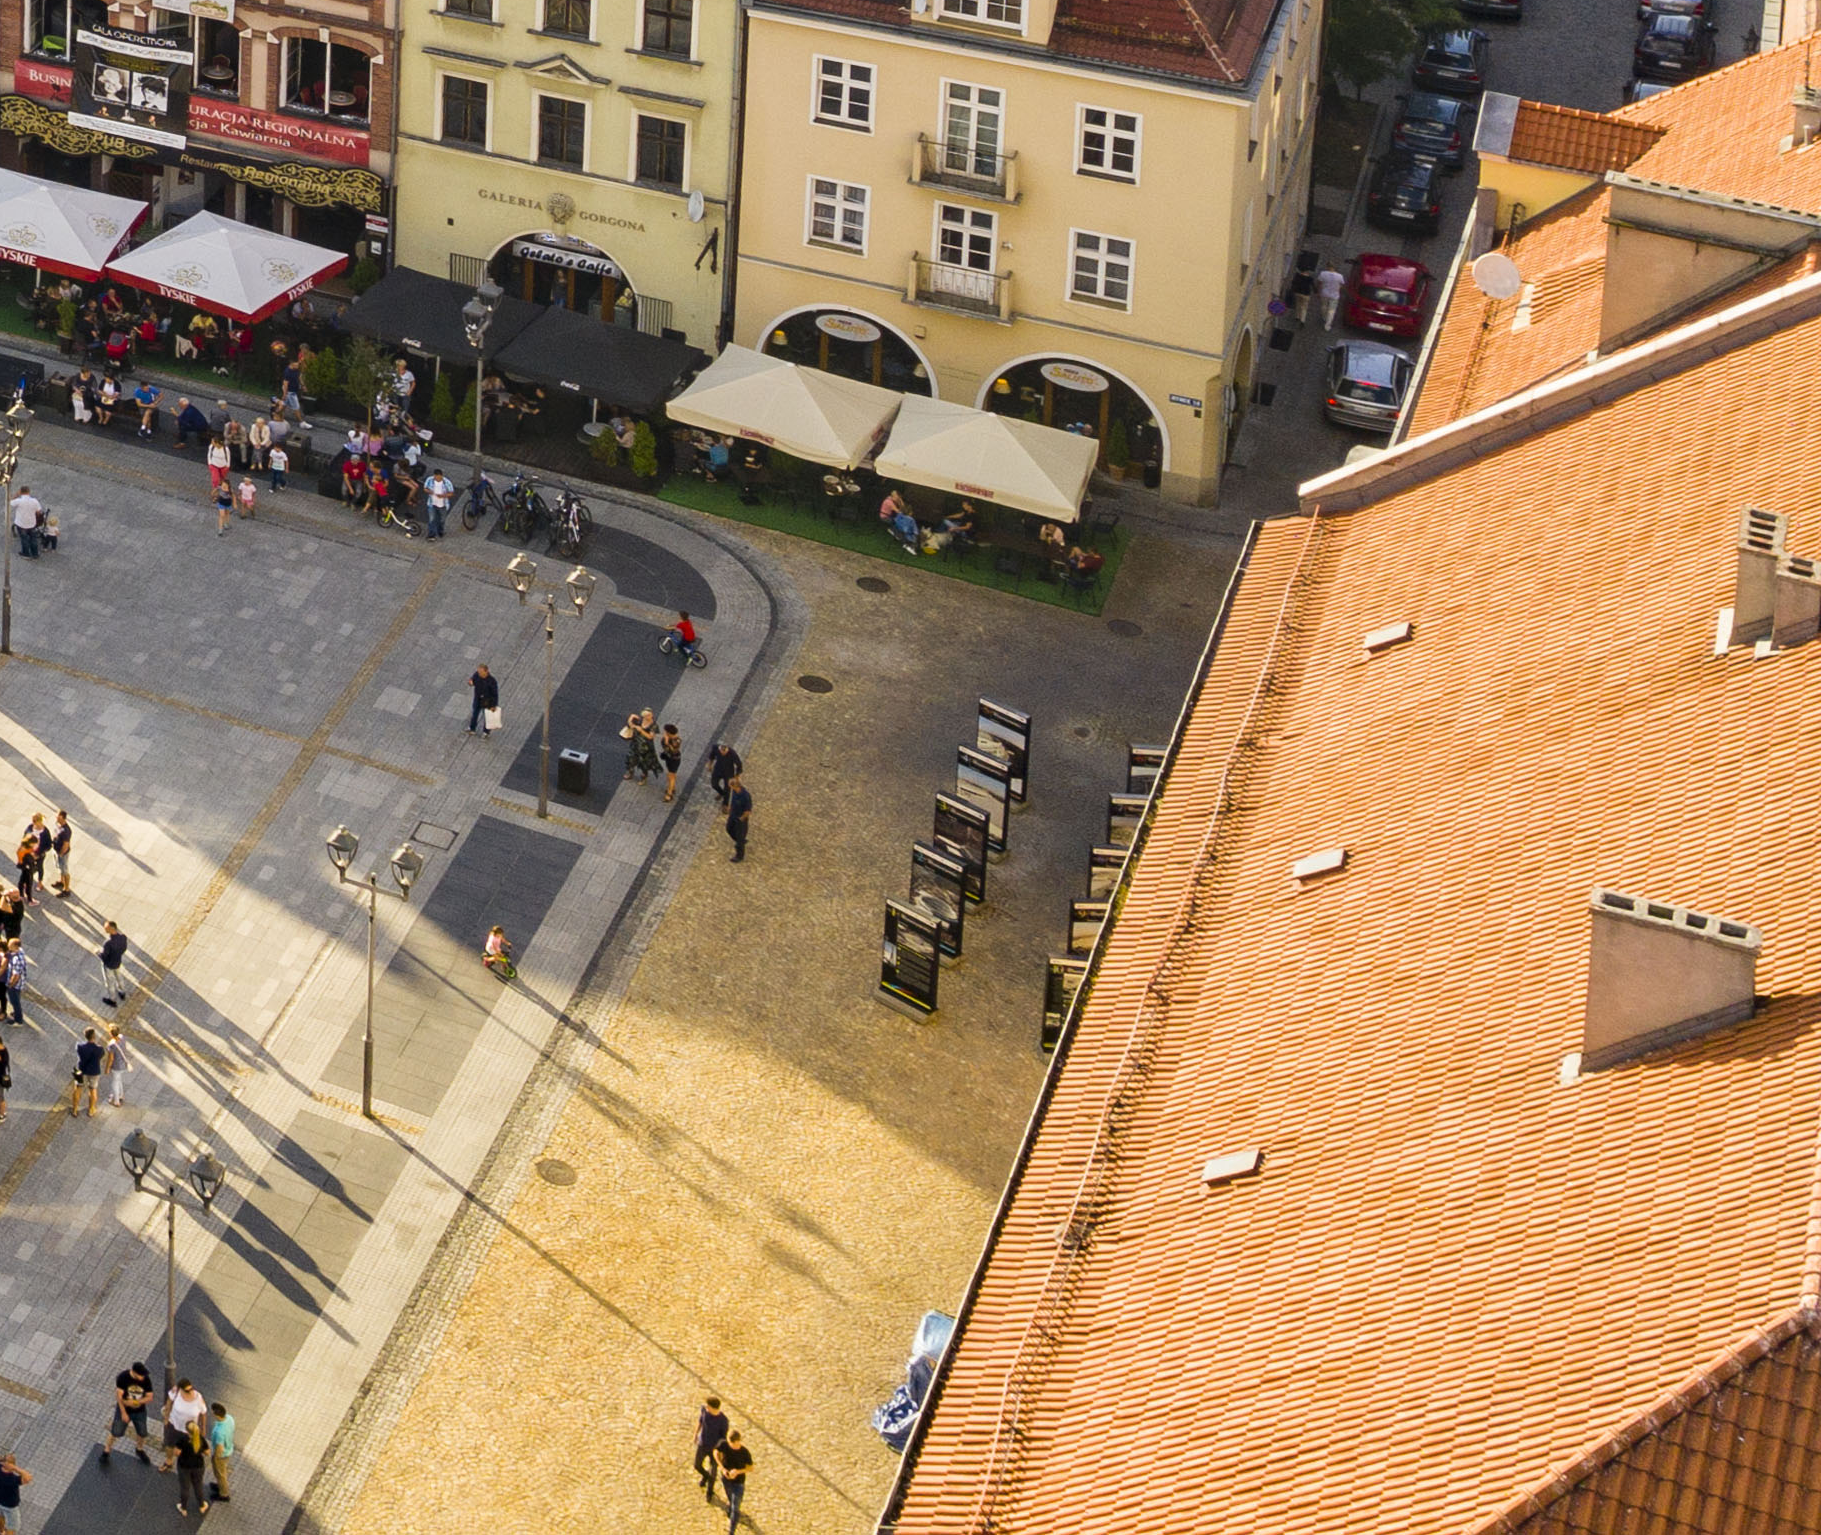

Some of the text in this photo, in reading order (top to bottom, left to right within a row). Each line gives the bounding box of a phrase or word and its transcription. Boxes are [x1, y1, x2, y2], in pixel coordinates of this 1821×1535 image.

[93, 135, 126, 149] PUB
[221, 125, 291, 147] Kawiarnia
[253, 115, 356, 148] REGIONALNA
[478, 189, 645, 232] GALERIA GORGONA
[159, 285, 197, 306] TYSKIE
[287, 277, 314, 300] TYSKIE
